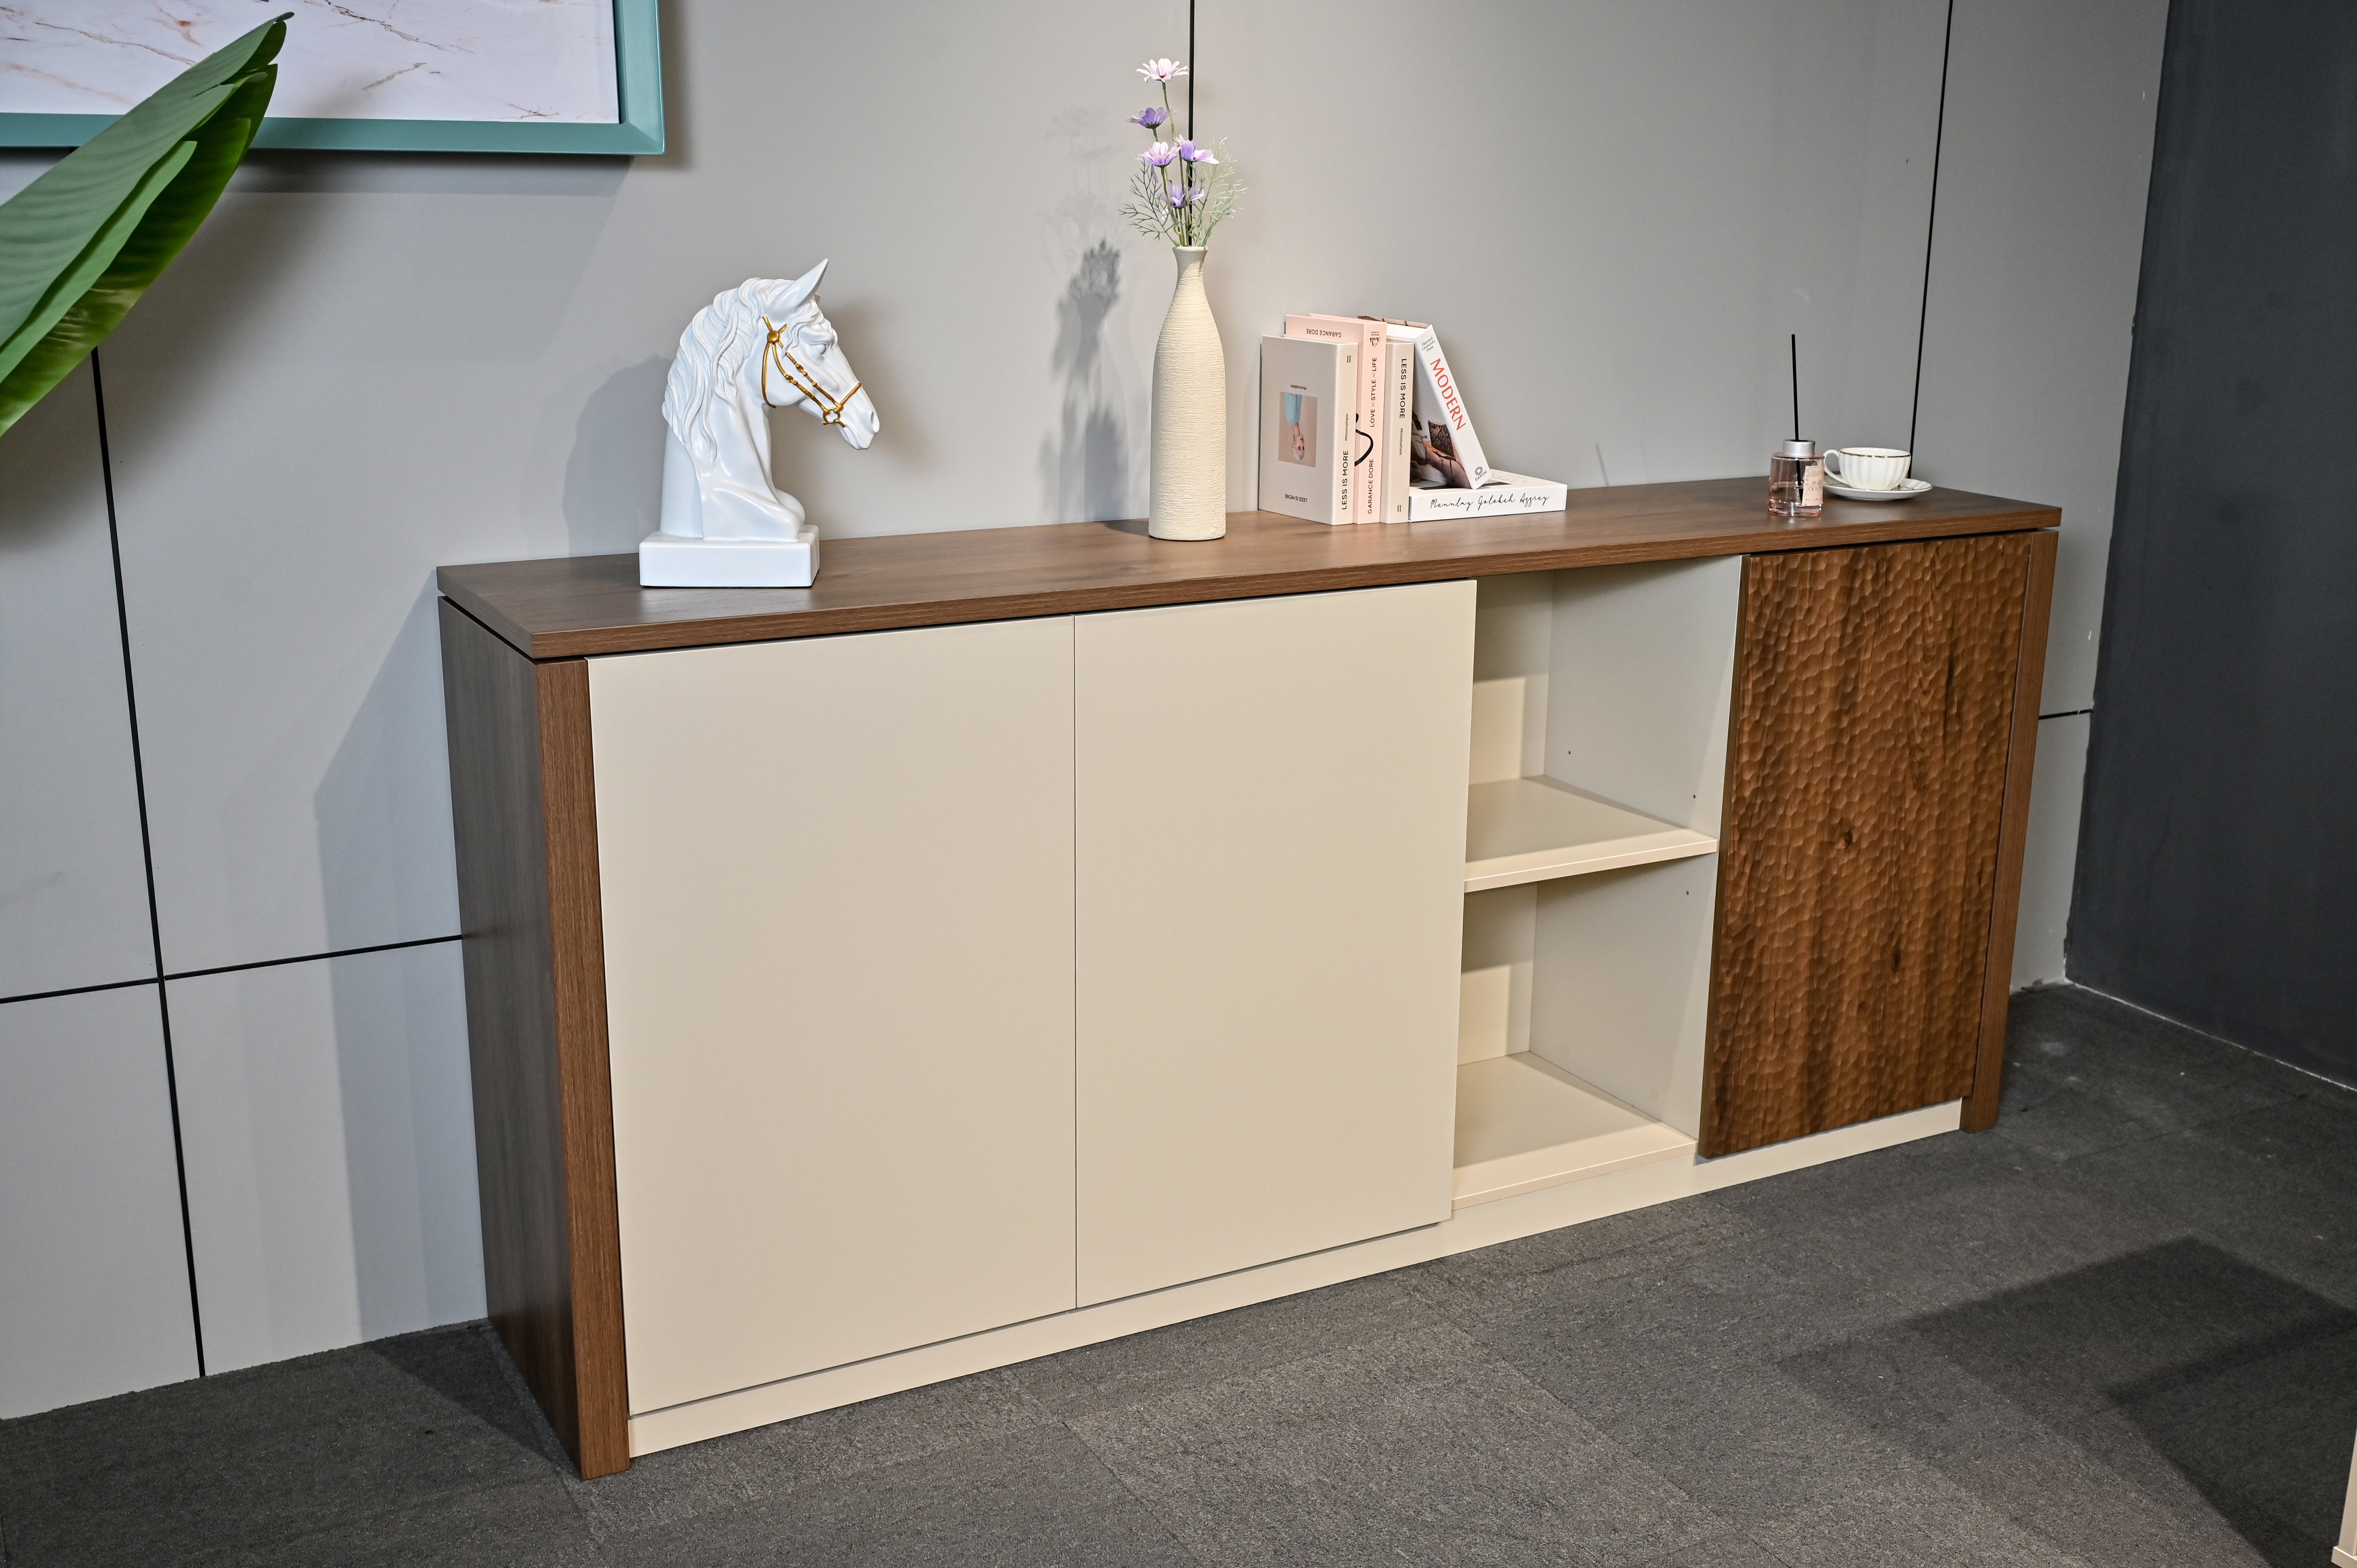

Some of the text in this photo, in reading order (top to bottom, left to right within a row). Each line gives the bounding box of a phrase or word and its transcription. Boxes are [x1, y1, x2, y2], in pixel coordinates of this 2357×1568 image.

[1430, 358, 1466, 430] MODERN
[1475, 470, 1487, 481] DAGON
[1342, 478, 1348, 486] IS
